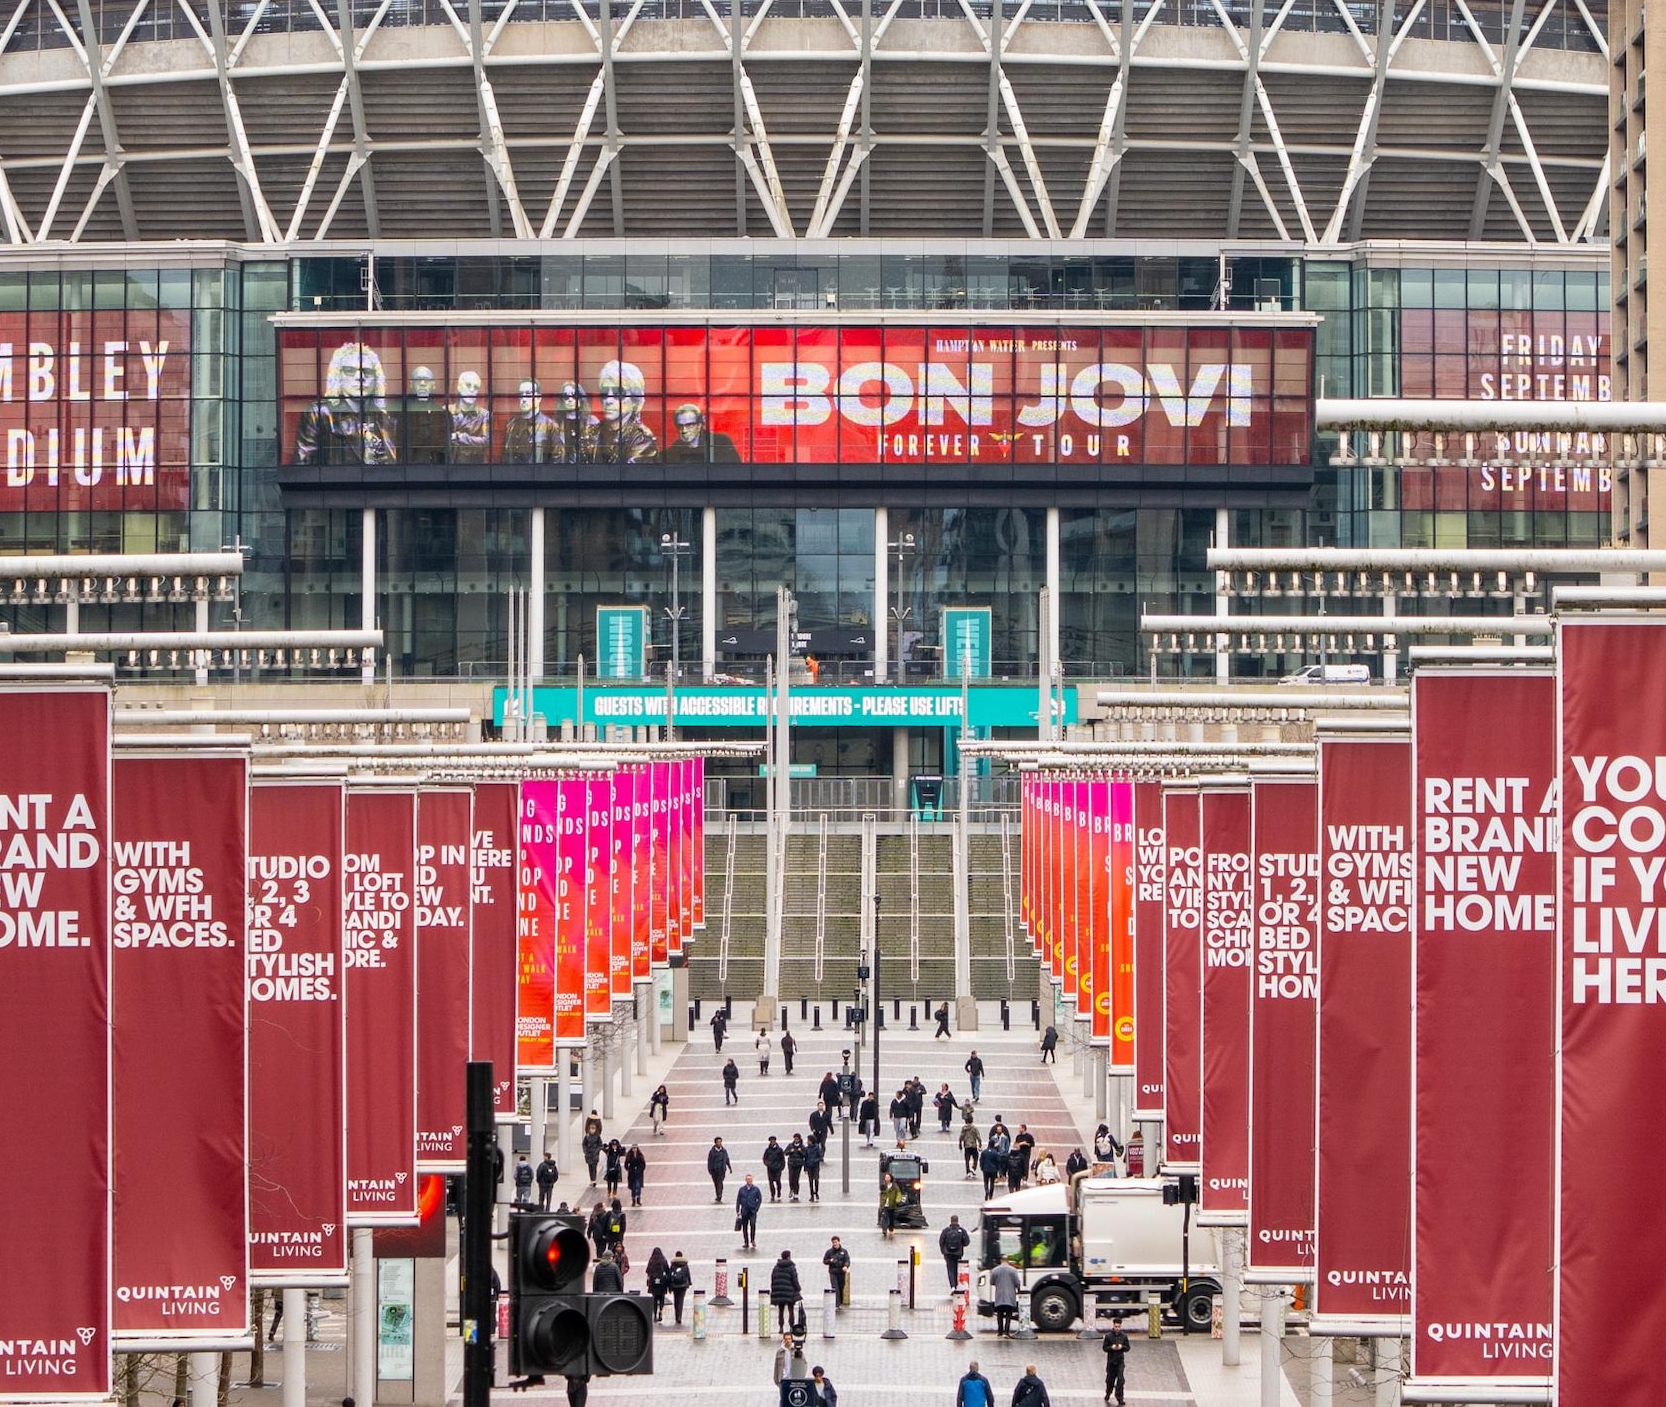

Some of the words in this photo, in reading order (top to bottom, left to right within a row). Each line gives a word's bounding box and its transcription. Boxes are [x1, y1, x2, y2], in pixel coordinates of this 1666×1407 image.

[1031, 339, 1077, 351] PRESENTS
[1502, 334, 1602, 367] FRIDAY
[760, 361, 993, 427] BON
[1017, 361, 1253, 428] JOVI
[1481, 373, 1612, 401] SEPTEMB
[878, 433, 981, 456] FOREVER
[1032, 433, 1131, 456] TOUR
[595, 696, 643, 716] GUESTS
[680, 696, 755, 716] ACCESSIBLE
[862, 696, 906, 716] PLEASE
[909, 696, 934, 716] USE
[1426, 778, 1529, 813] RENT
[63, 794, 95, 829] A
[523, 824, 554, 844] NDS
[1328, 826, 1403, 850] WITH
[114, 842, 189, 866] WITH
[441, 845, 465, 865] IN
[1169, 847, 1200, 867] PO
[1328, 852, 1412, 878] GYMS
[114, 868, 203, 894] GYMS
[354, 872, 403, 892] LOFT
[522, 867, 542, 886] OP
[1169, 868, 1200, 887] AN
[1207, 873, 1237, 890] NY
[1426, 856, 1522, 891] NEW
[1574, 857, 1615, 902] IF
[262, 880, 286, 907] 2,
[293, 880, 310, 903] 3
[380, 892, 409, 911] TO
[1261, 878, 1282, 905] 1,
[1290, 878, 1314, 905] 2,
[1328, 879, 1350, 904] &
[115, 896, 136, 921] &
[145, 895, 211, 920] WFH
[279, 905, 297, 927] 4
[1169, 909, 1200, 928] TO
[1207, 910, 1251, 929] SCA
[1259, 902, 1300, 925] OR
[1327, 906, 1412, 932] SPAC
[1426, 894, 1554, 931] HOME
[114, 922, 234, 948] SPACES.
[250, 929, 283, 952] ED
[381, 930, 398, 949] &
[1259, 927, 1310, 950] BED
[1258, 950, 1318, 974] STYL
[248, 978, 337, 1001] OMES.
[348, 1179, 396, 1190] NTAIN
[353, 1191, 396, 1202] LIVING
[273, 1244, 323, 1258] LIVING
[117, 1286, 219, 1301] QUINTAIN
[163, 1302, 219, 1314] LIVING
[1428, 1324, 1552, 1341] QUINTAIN
[1484, 1343, 1552, 1358] LIVING
[7, 1360, 75, 1374] LIVING
